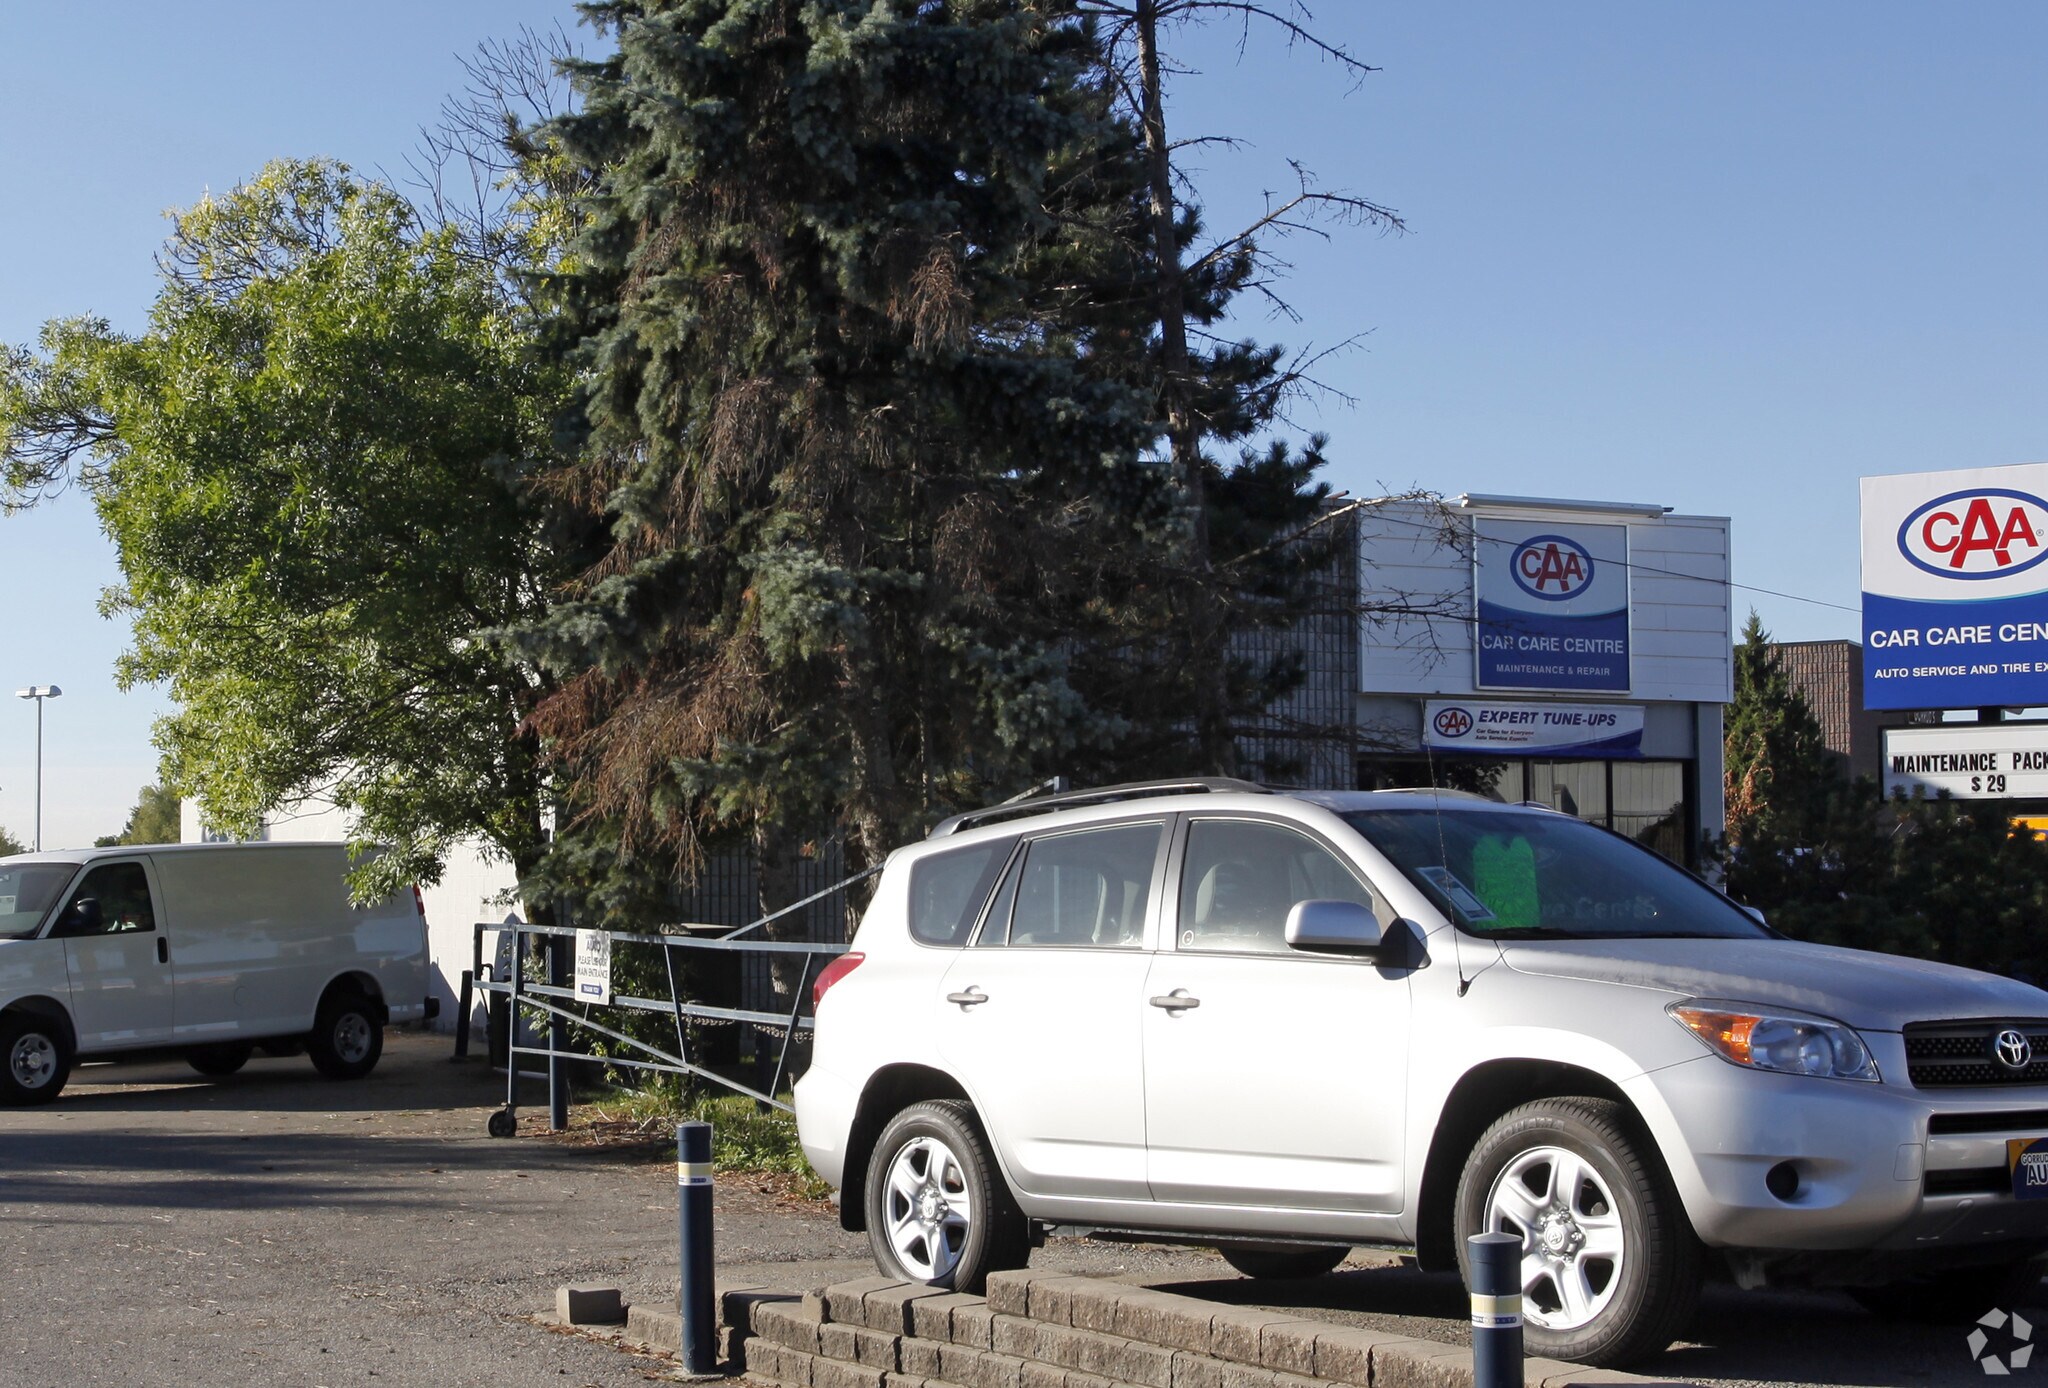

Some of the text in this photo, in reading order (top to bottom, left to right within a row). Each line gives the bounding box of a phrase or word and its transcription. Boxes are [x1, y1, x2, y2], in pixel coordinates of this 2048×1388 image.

[1922, 498, 2039, 569] CAA
[1520, 543, 1584, 592] CAA
[1481, 634, 1624, 654] CAR CARE CENTRE
[1870, 629, 1919, 648] CAR
[1926, 625, 1991, 646] CARE
[1496, 664, 1610, 676] MAINTENANCE & REPAIR
[1874, 668, 1909, 679] AUTO
[1912, 665, 1966, 677] SERVICE
[1970, 664, 1998, 675] AND
[2002, 662, 2031, 673] TIRE
[1438, 710, 1469, 733] CAA
[1478, 710, 1617, 727] EXPERT TUNE-UPS
[1893, 753, 1997, 773] MAINTENANCE
[1987, 774, 2006, 792] 29
